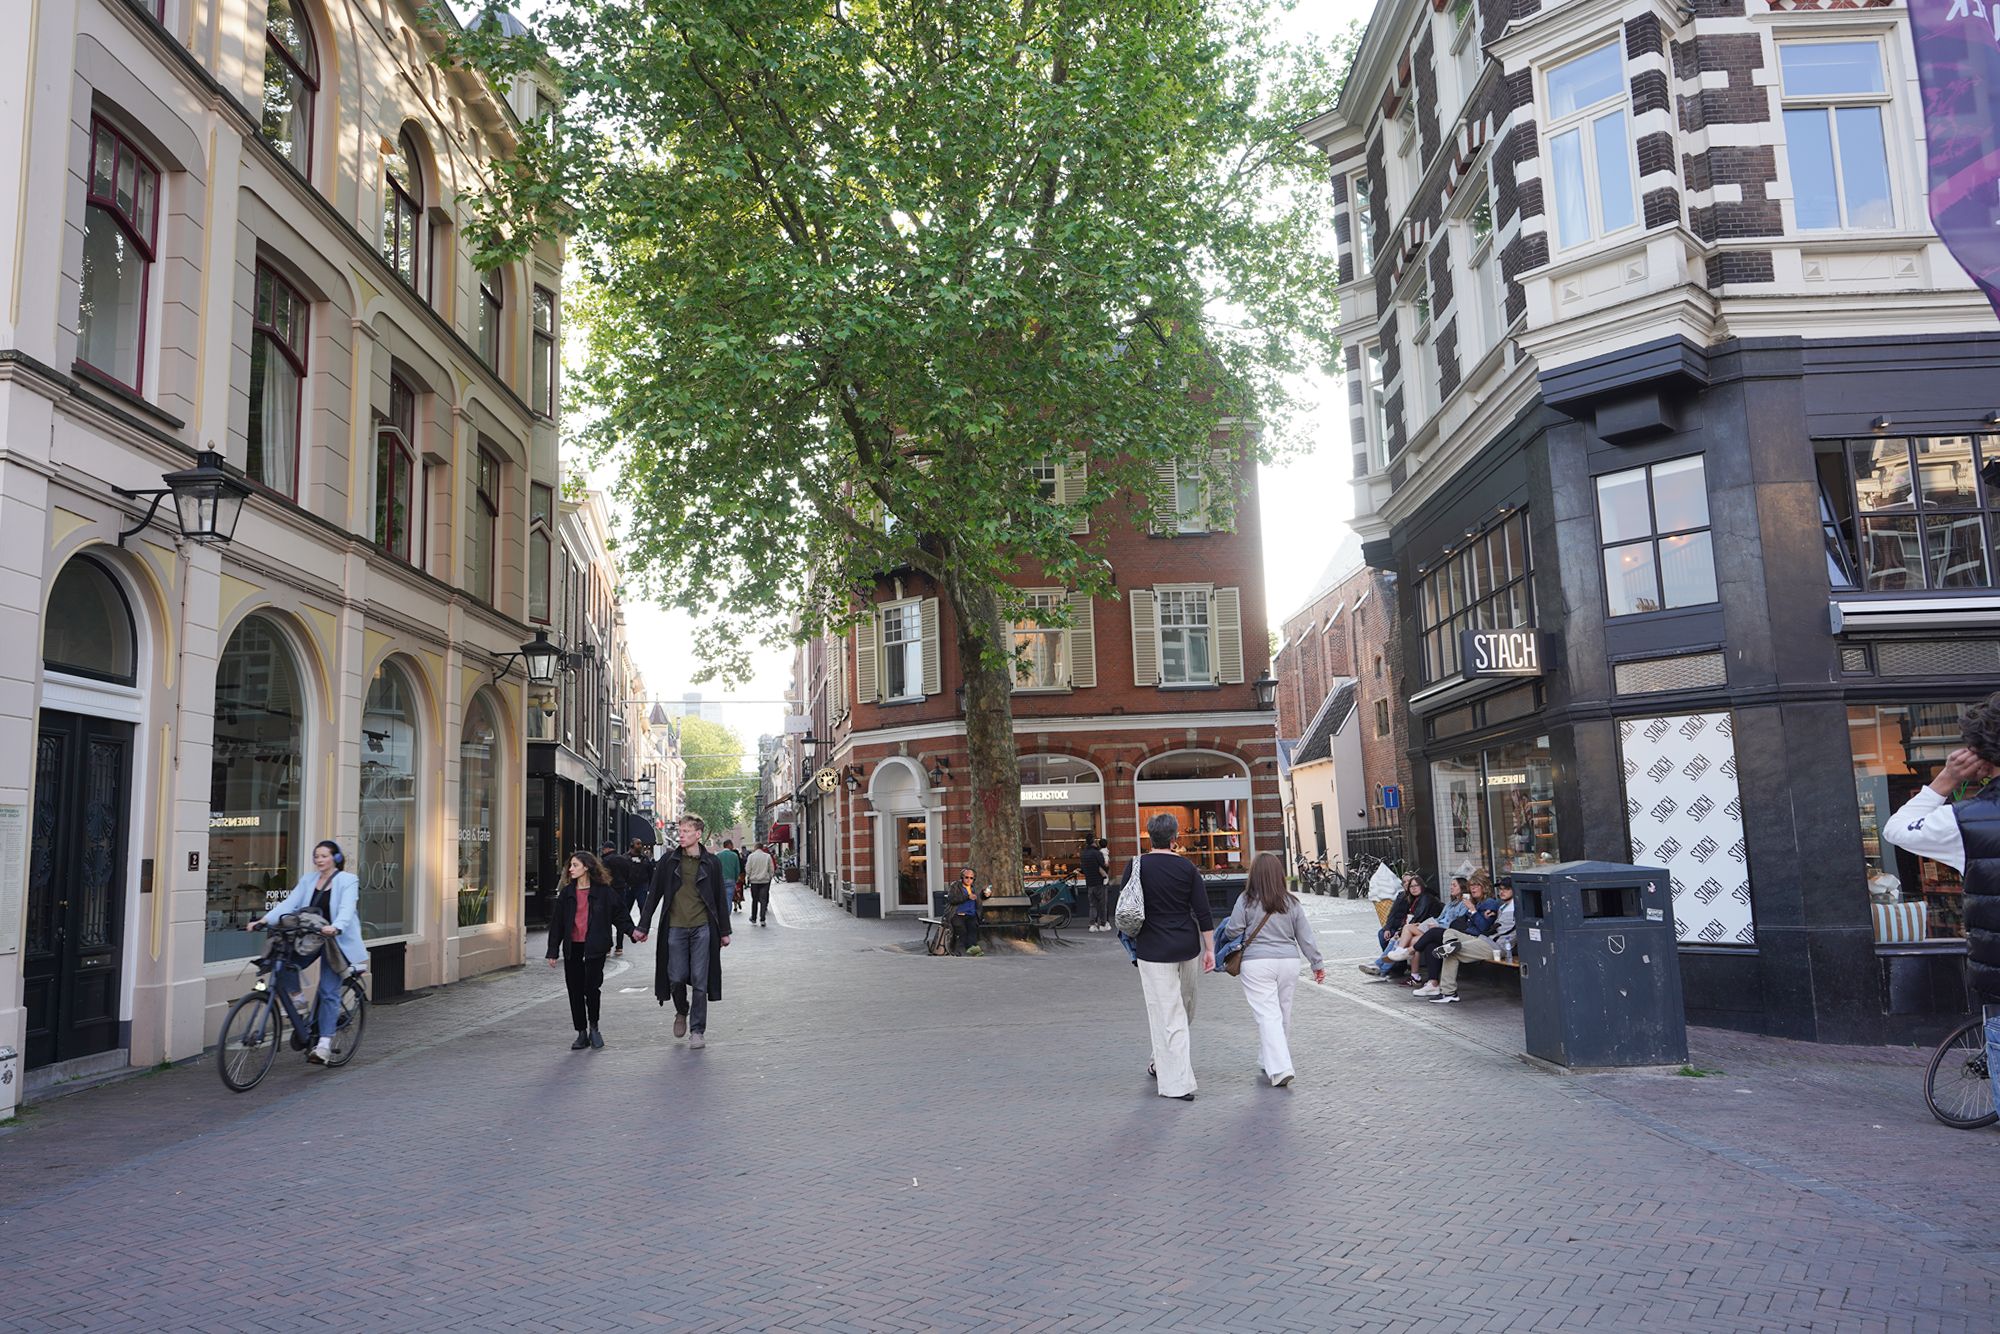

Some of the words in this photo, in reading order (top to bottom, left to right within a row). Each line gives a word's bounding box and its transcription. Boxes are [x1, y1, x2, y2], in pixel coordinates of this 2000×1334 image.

[1474, 633, 1536, 669] STACH
[1643, 717, 1671, 743] STACH
[1679, 714, 1707, 741] STACH
[1647, 755, 1674, 783] STACH
[1683, 753, 1711, 781] STACH
[1021, 790, 1069, 800] BIRKENSTOCK
[1686, 794, 1715, 822] STACH
[1650, 796, 1678, 823] STACH
[1654, 836, 1682, 864] STACH
[1690, 835, 1719, 863] STACH
[266, 890, 279, 899] FOR
[1694, 877, 1722, 905] STACH
